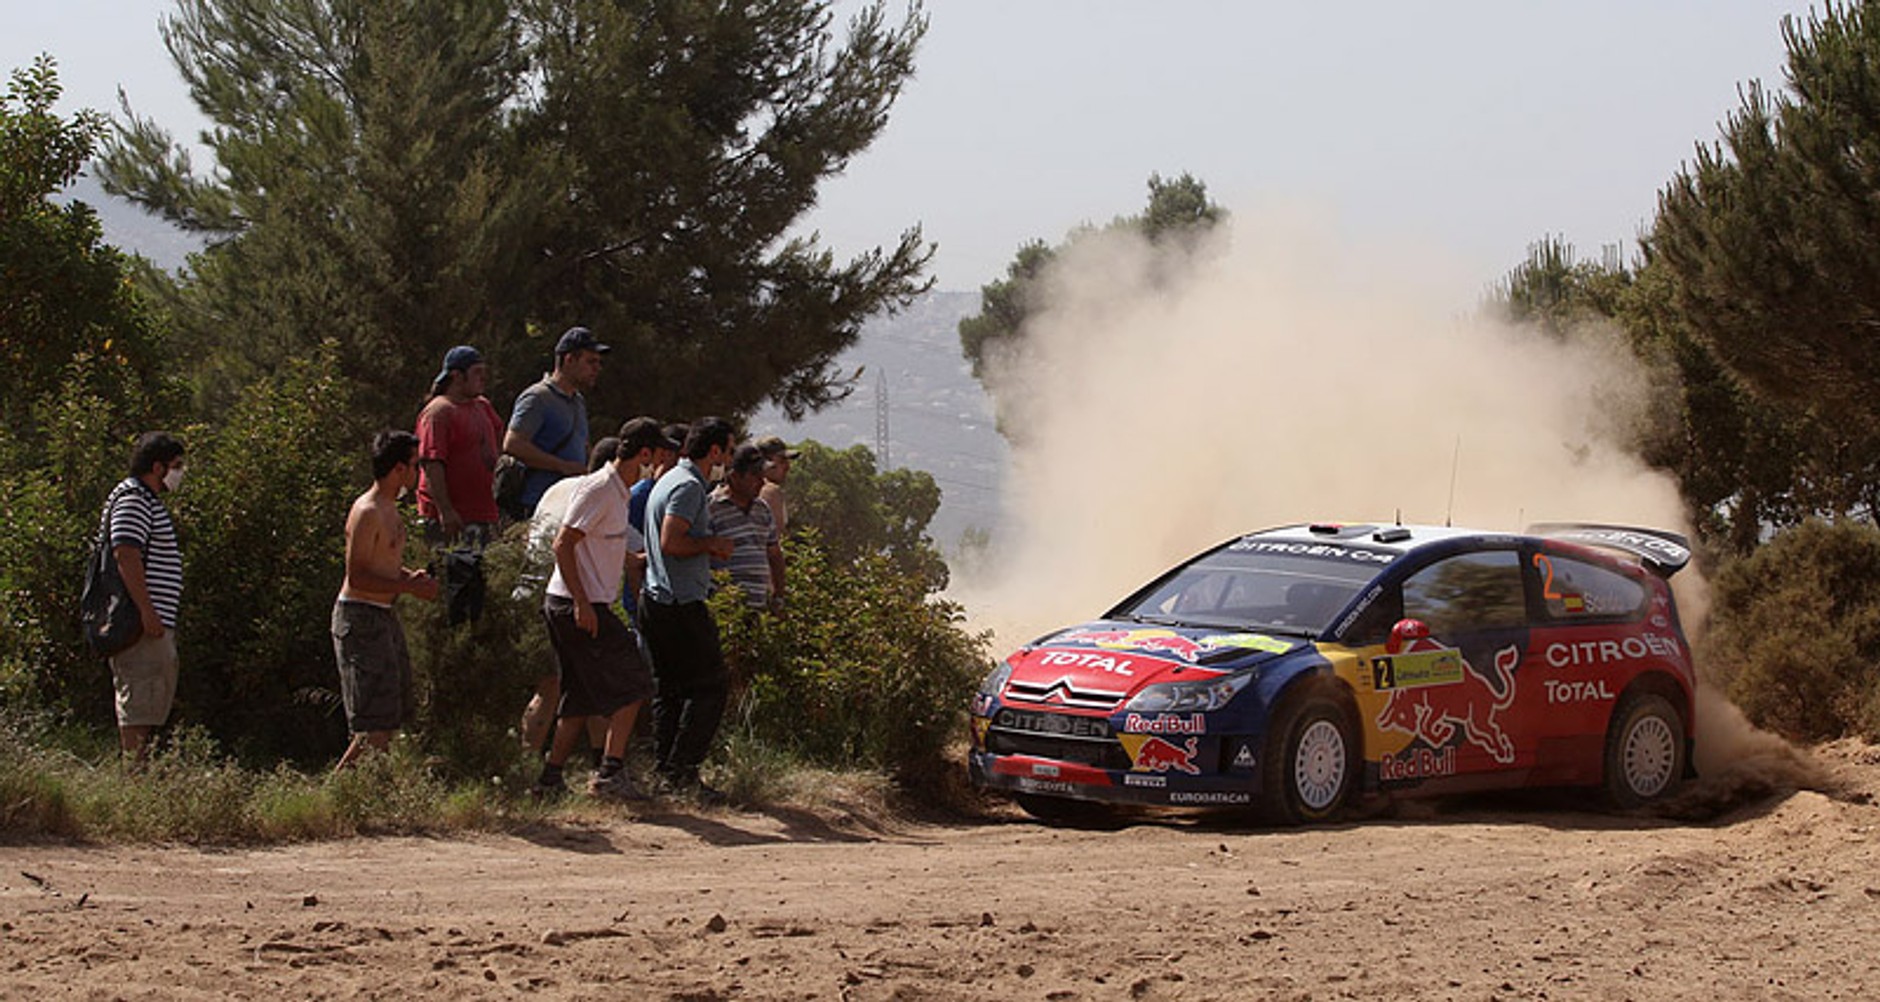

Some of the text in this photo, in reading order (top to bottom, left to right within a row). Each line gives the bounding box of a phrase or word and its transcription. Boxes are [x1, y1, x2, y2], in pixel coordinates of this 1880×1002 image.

[1351, 550, 1395, 564] C4
[1532, 553, 1561, 599] 2
[1546, 632, 1681, 668] CITROËN
[1041, 651, 1134, 676] TOTAL
[1378, 660, 1390, 688] 2
[1544, 680, 1615, 704] TOTAL
[1000, 710, 1109, 736] CITROËN
[1124, 713, 1206, 735] Red Bull
[1381, 746, 1456, 780] Red Bull
[1169, 791, 1250, 803] EURODATACAR
